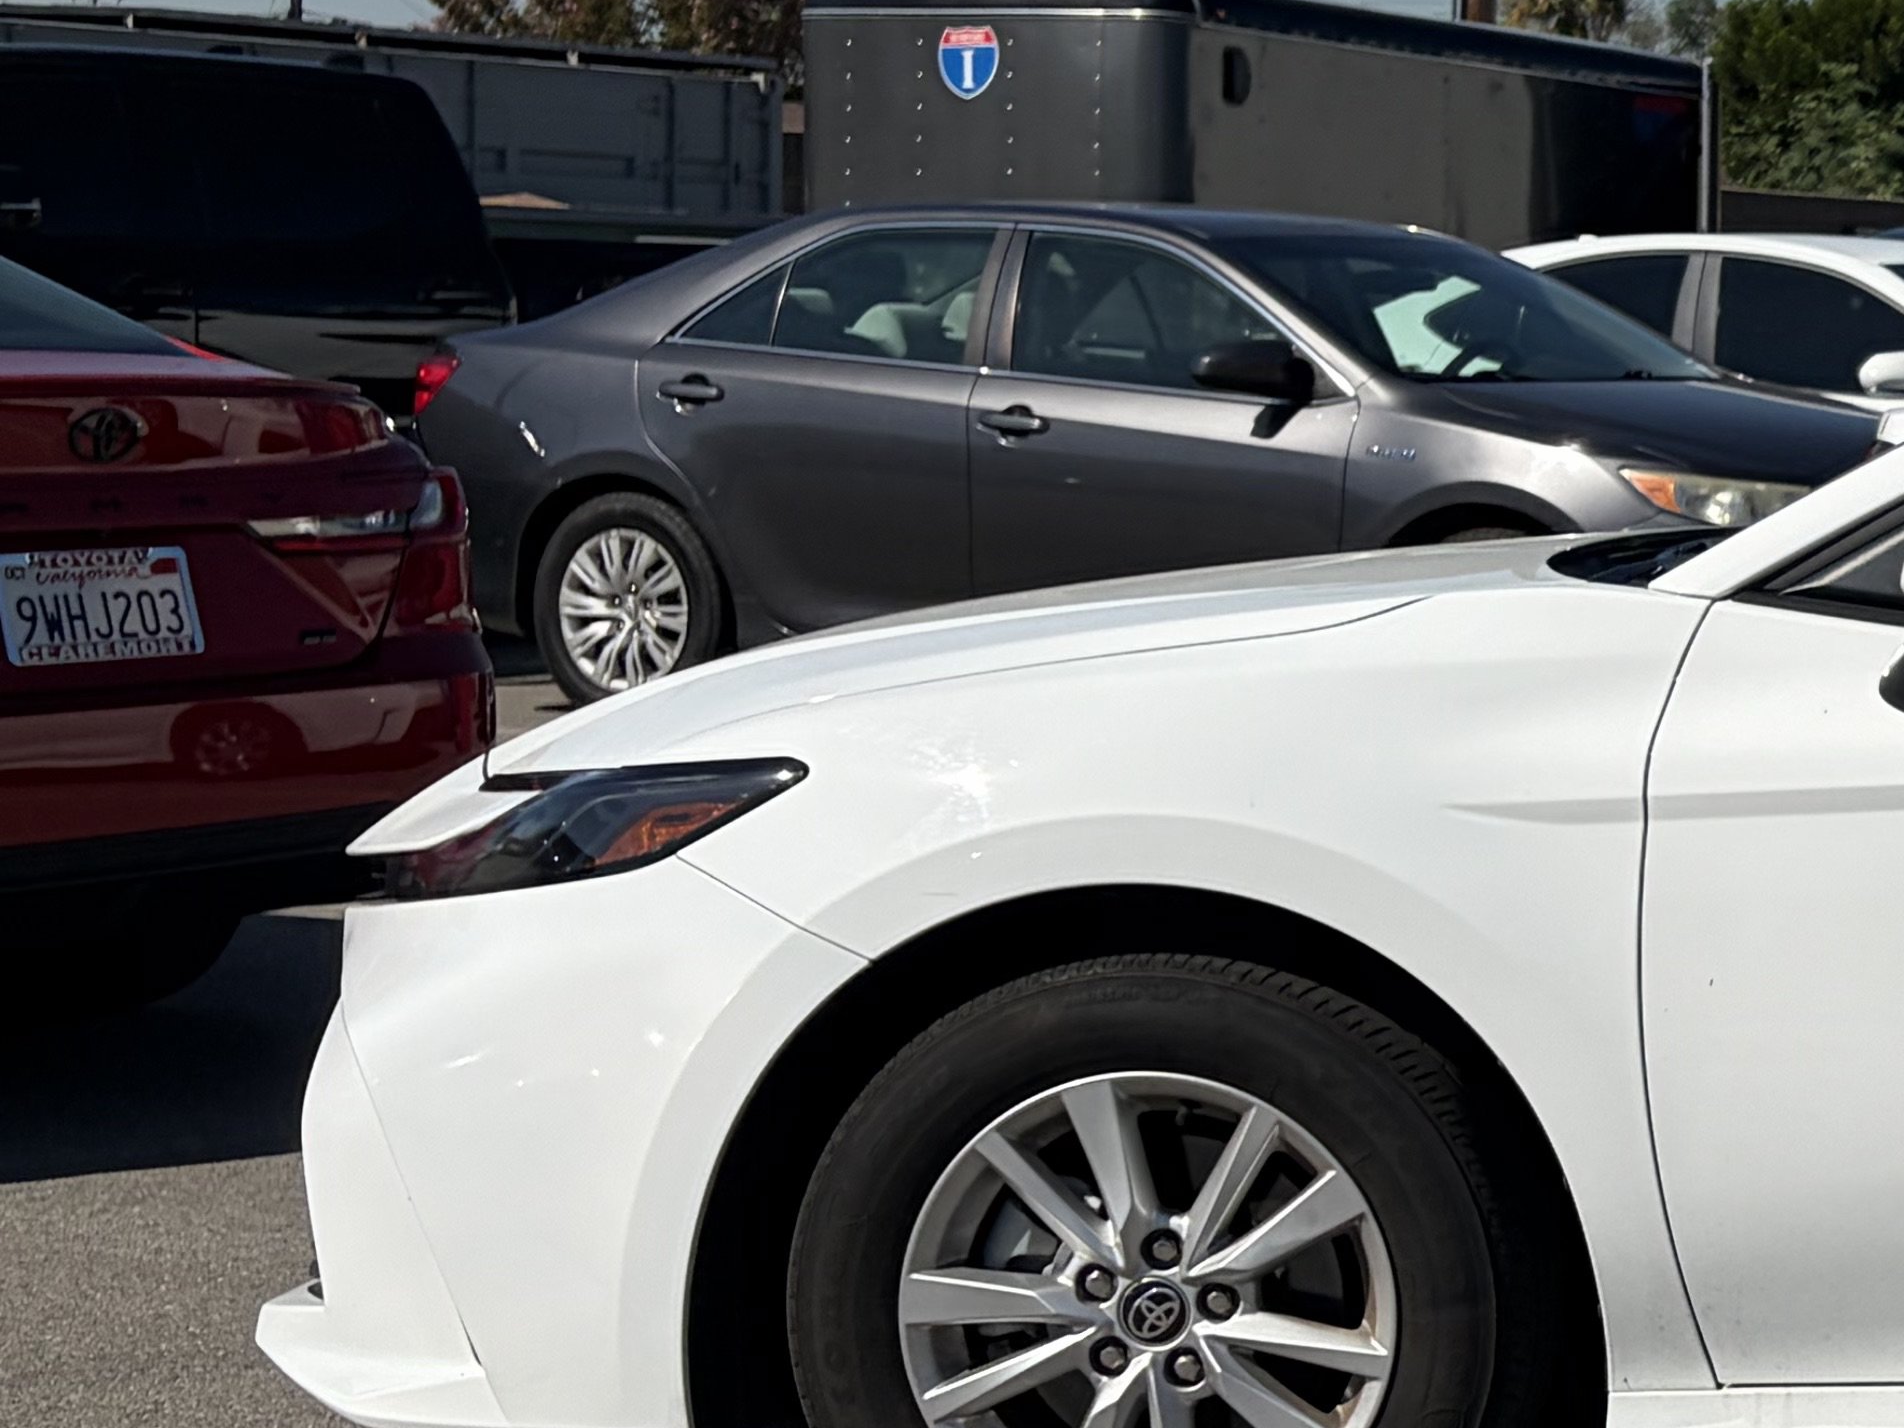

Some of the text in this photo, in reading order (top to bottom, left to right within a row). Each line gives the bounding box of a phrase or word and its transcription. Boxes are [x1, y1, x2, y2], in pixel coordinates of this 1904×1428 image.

[41, 549, 144, 569] TOYOTA
[35, 565, 144, 589] California
[16, 589, 185, 646] 9WHJ203
[22, 636, 194, 663] CLAREMONT
